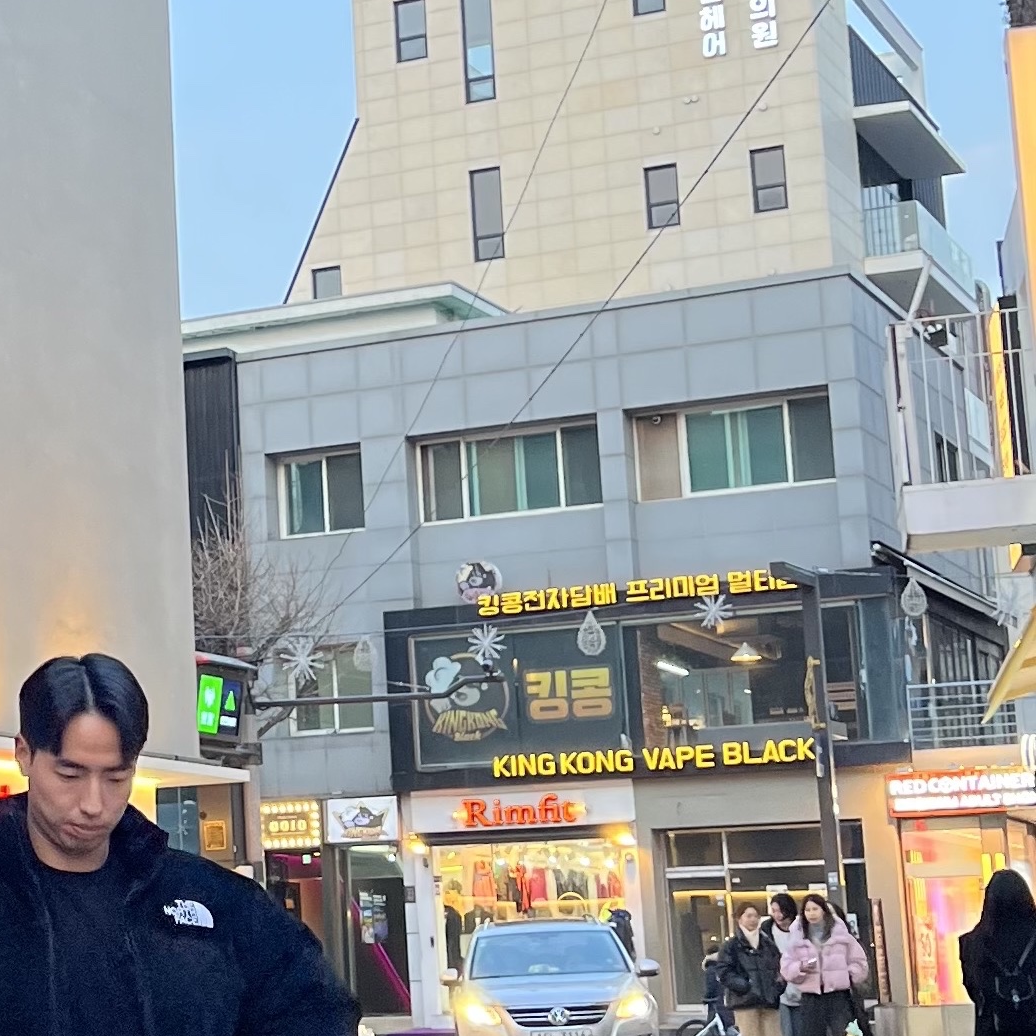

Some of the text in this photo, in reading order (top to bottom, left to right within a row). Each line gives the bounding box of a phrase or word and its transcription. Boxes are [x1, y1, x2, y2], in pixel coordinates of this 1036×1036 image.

[477, 583, 617, 617] 킹콩전자담배
[626, 573, 719, 602] 프리미엄
[525, 667, 613, 721] 킹콩
[493, 737, 816, 778] KING KONG VAPE BLACK
[889, 779, 927, 796] RED
[462, 794, 578, 828] Rimfit
[163, 905, 197, 917] NORTH
